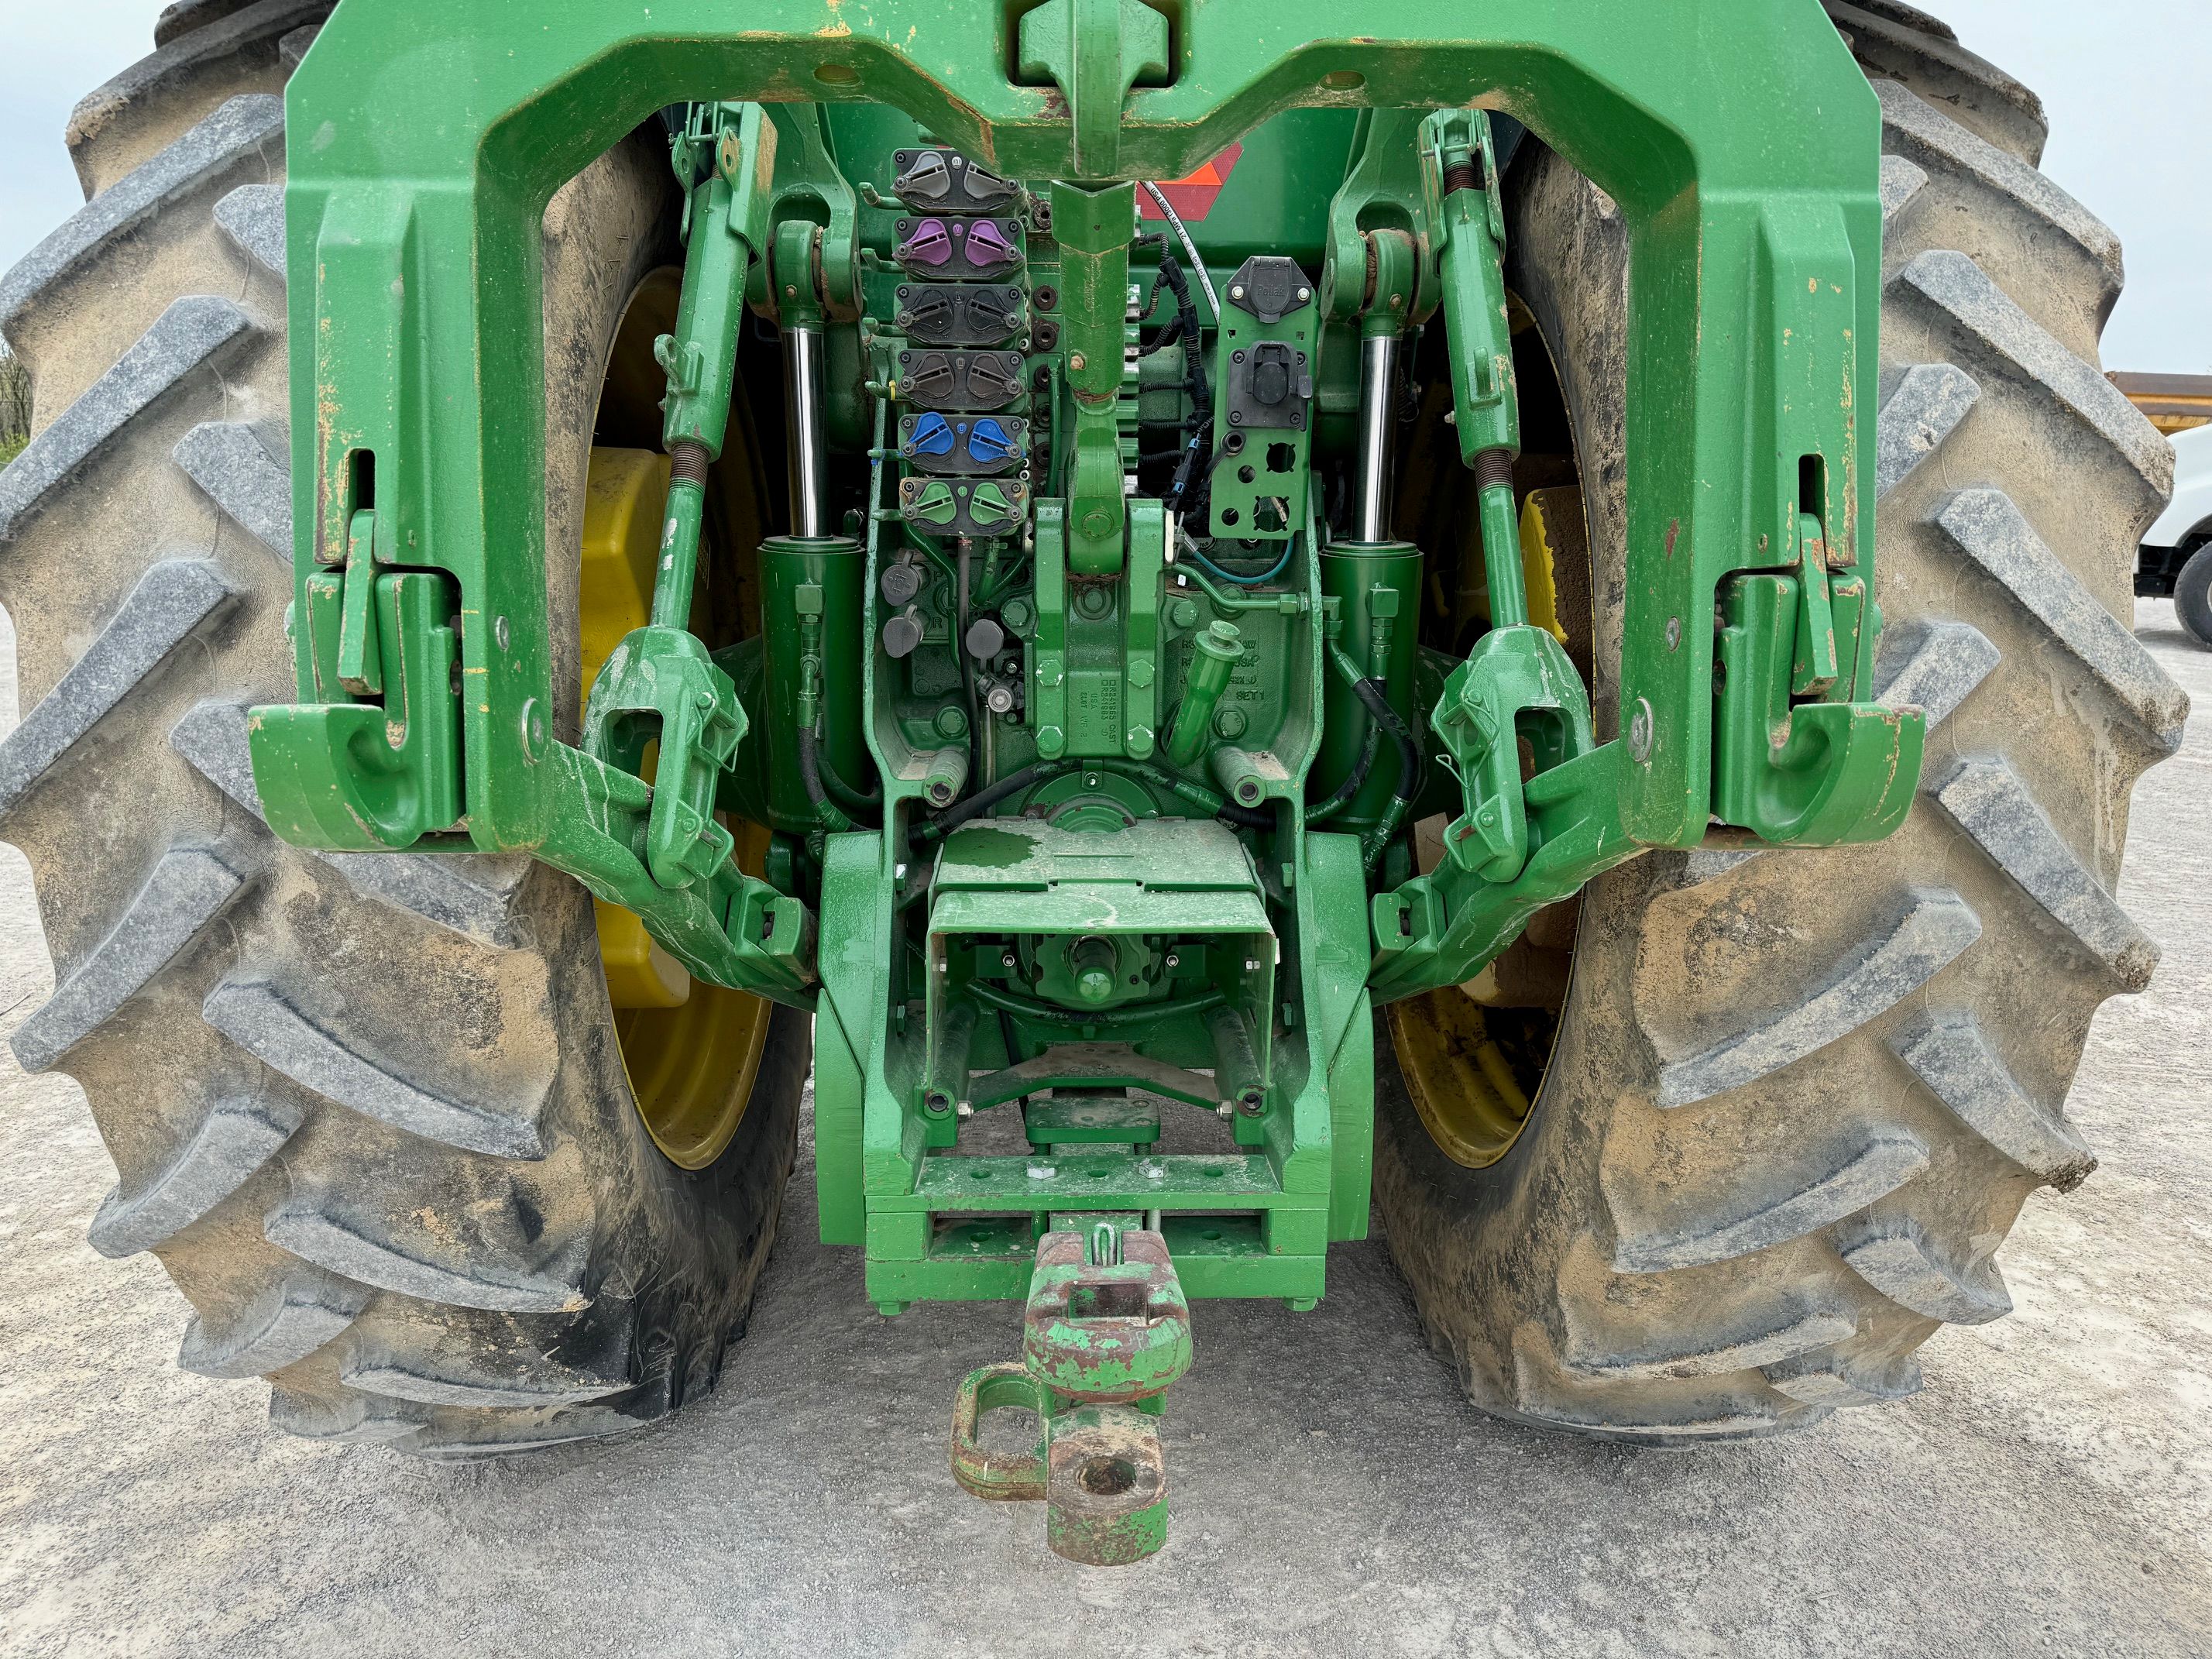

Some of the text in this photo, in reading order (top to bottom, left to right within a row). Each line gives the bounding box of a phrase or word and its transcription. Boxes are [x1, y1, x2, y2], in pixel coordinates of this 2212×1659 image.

[1150, 187, 1160, 201] PSI)
[1160, 200, 1173, 218] (3000
[1172, 216, 1182, 232] MPa
[1258, 284, 1286, 297] Pollak
[933, 617, 942, 628] R
